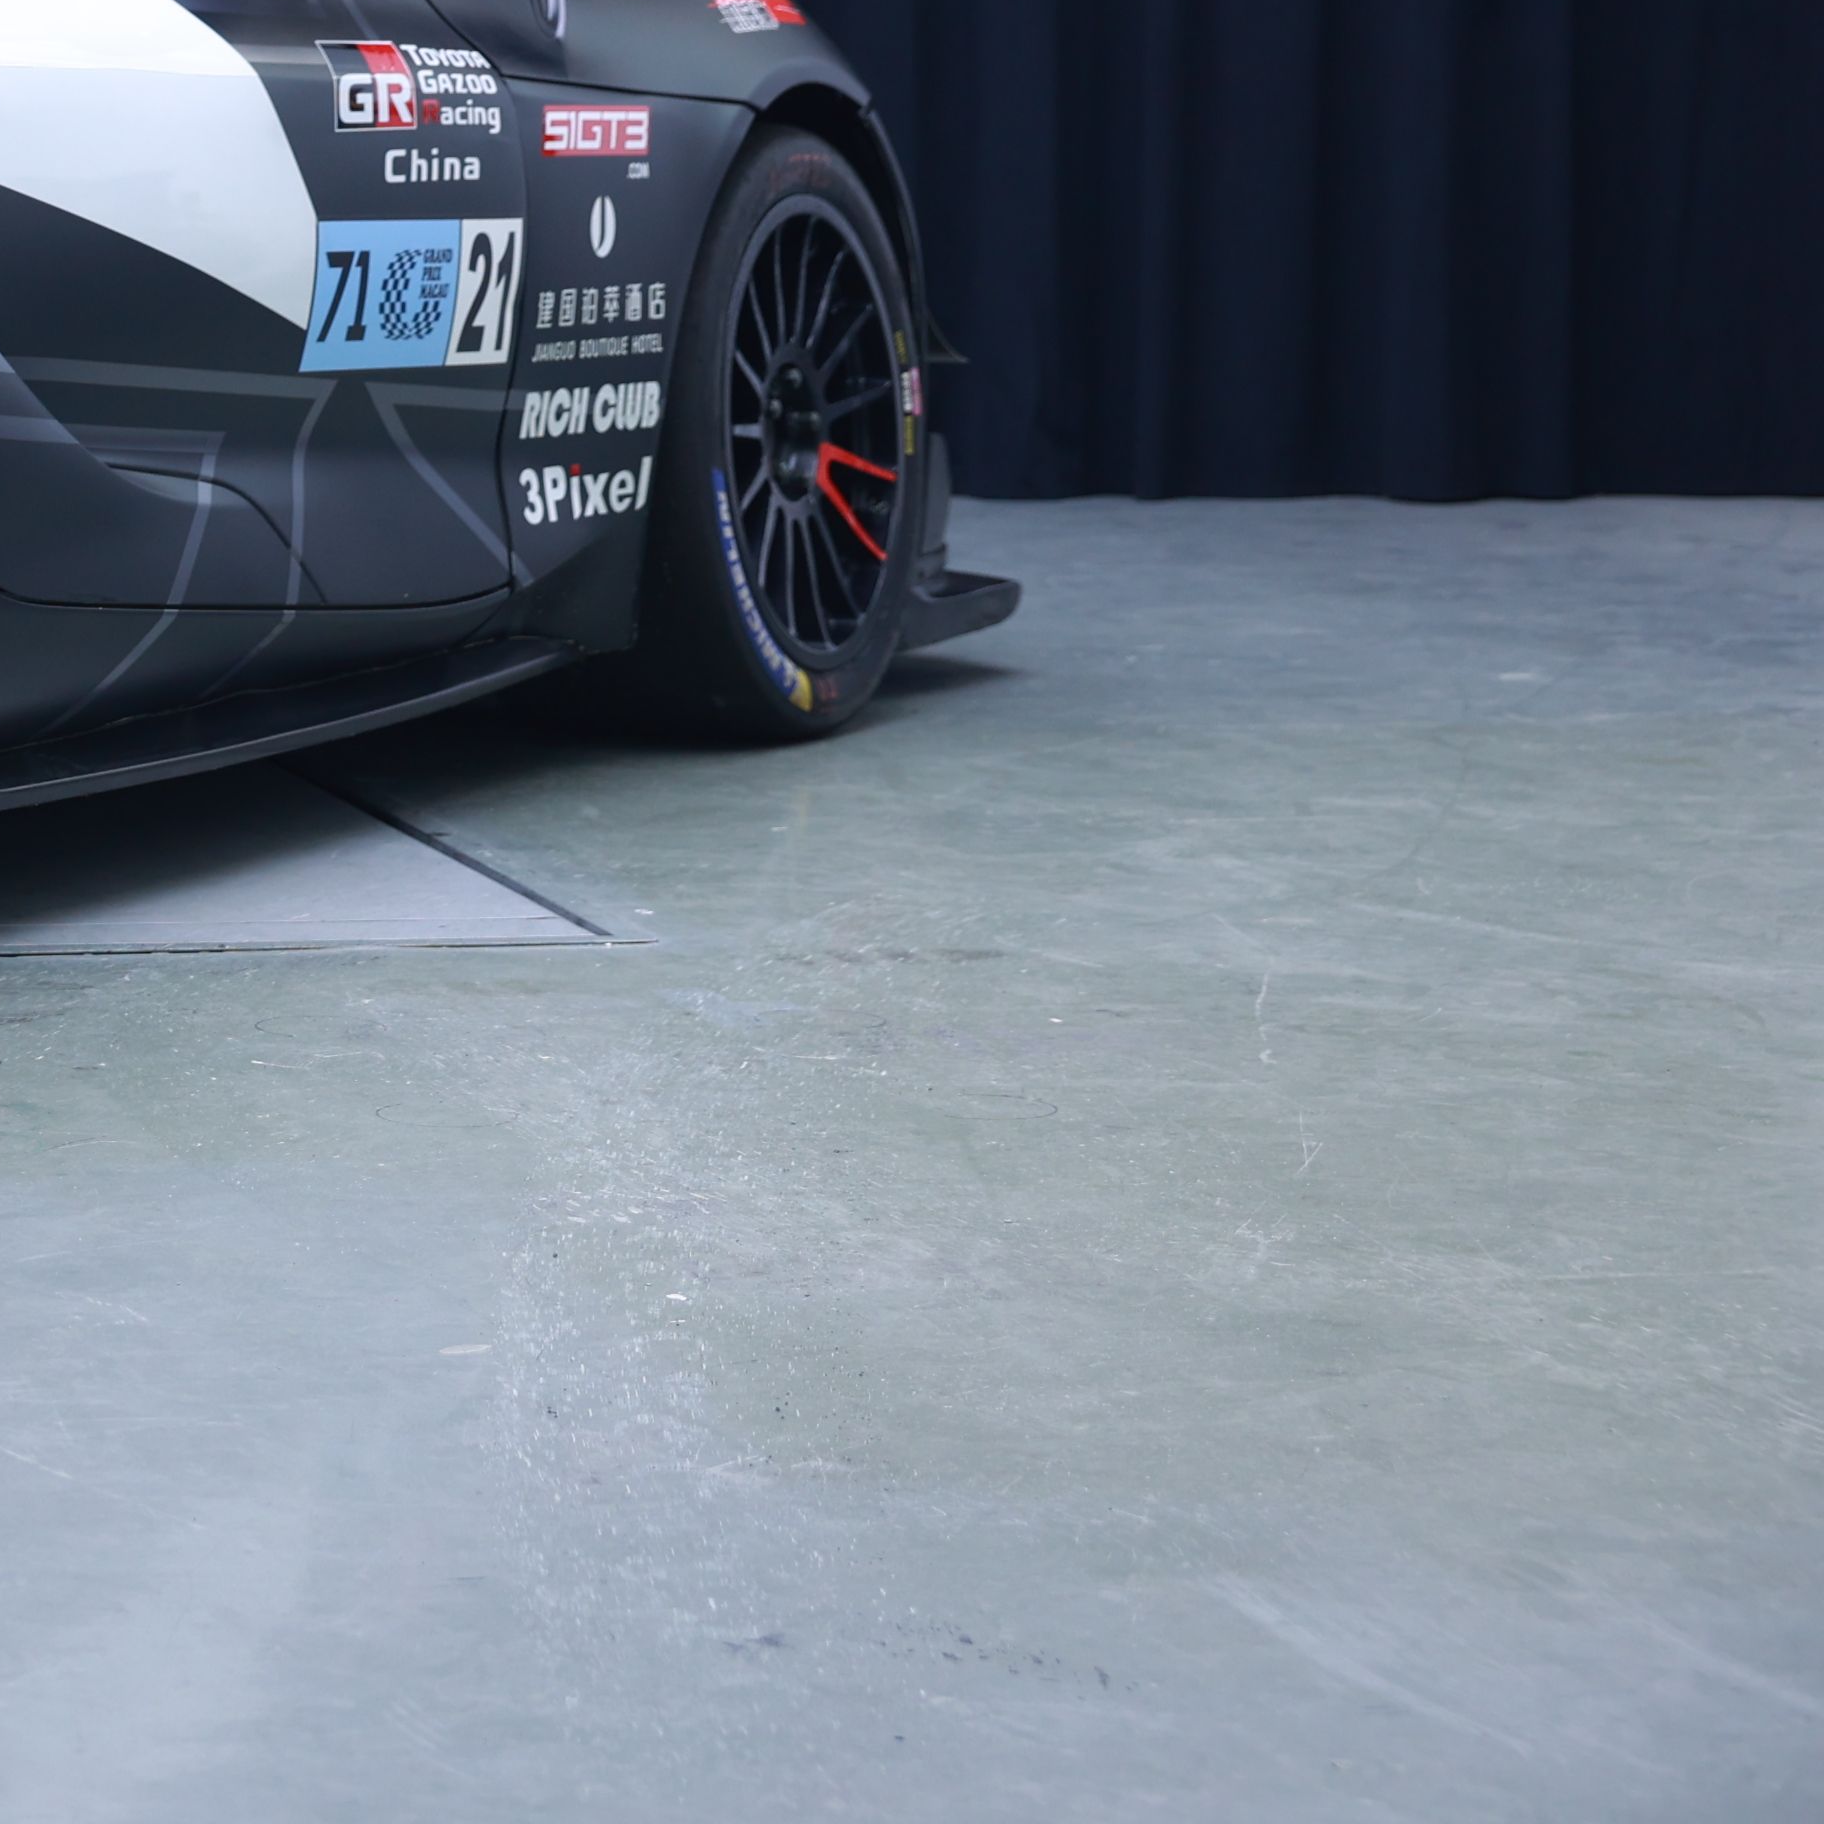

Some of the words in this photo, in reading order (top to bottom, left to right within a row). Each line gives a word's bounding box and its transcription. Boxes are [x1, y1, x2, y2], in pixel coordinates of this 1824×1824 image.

[400, 44, 491, 69] TOYOTA
[339, 72, 414, 124] GR
[417, 70, 498, 94] GAZOO
[422, 99, 501, 134] Racing
[384, 148, 481, 183] China
[423, 249, 453, 263] GRAND
[421, 267, 442, 281] PRIX
[316, 250, 370, 342] 71
[456, 232, 515, 353] 21
[519, 386, 591, 439] RICH
[592, 381, 661, 434] CLUB
[519, 456, 653, 525] 3Pixel
